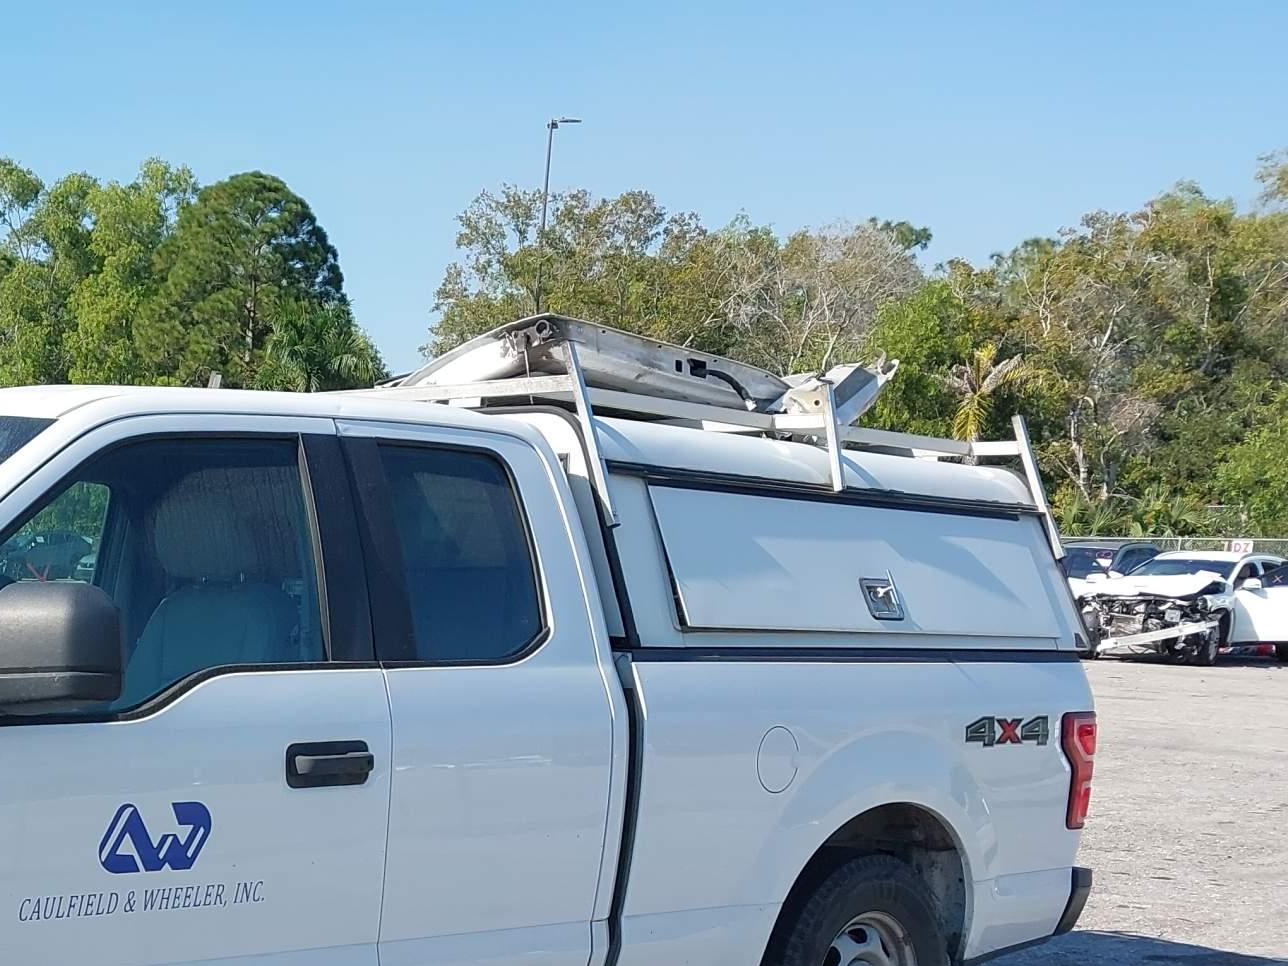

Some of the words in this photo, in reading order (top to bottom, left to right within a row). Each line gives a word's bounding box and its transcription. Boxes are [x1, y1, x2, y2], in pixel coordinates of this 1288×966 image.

[18, 892, 119, 922] CAULFIELD
[124, 890, 136, 913] &
[143, 883, 228, 911] WHEELER,
[233, 880, 265, 904] INC.
